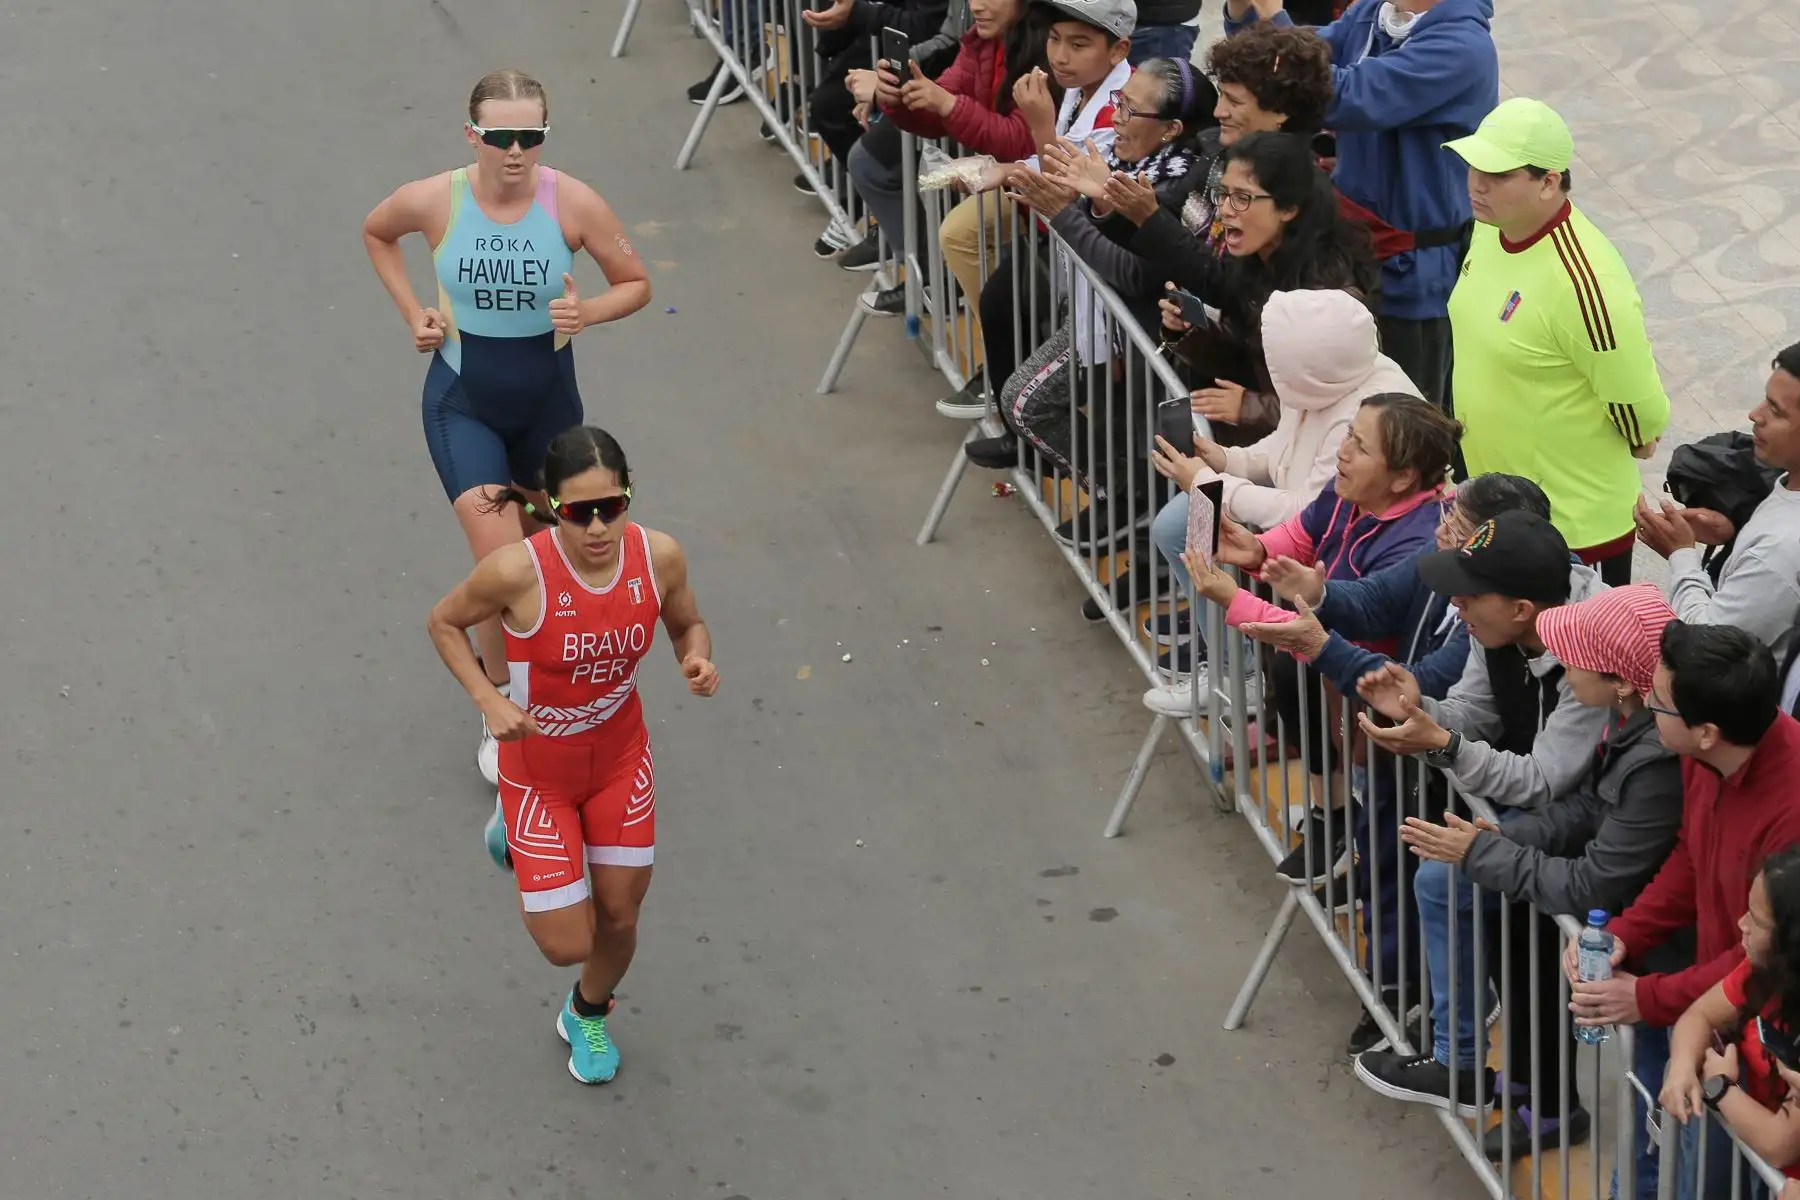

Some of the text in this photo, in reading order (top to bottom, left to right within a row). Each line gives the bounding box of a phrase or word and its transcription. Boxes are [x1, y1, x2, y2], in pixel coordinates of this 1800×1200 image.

[458, 257, 550, 286] HAWLEY
[474, 289, 537, 311] BER
[562, 623, 645, 662] BRAVO
[571, 658, 629, 684] PER
